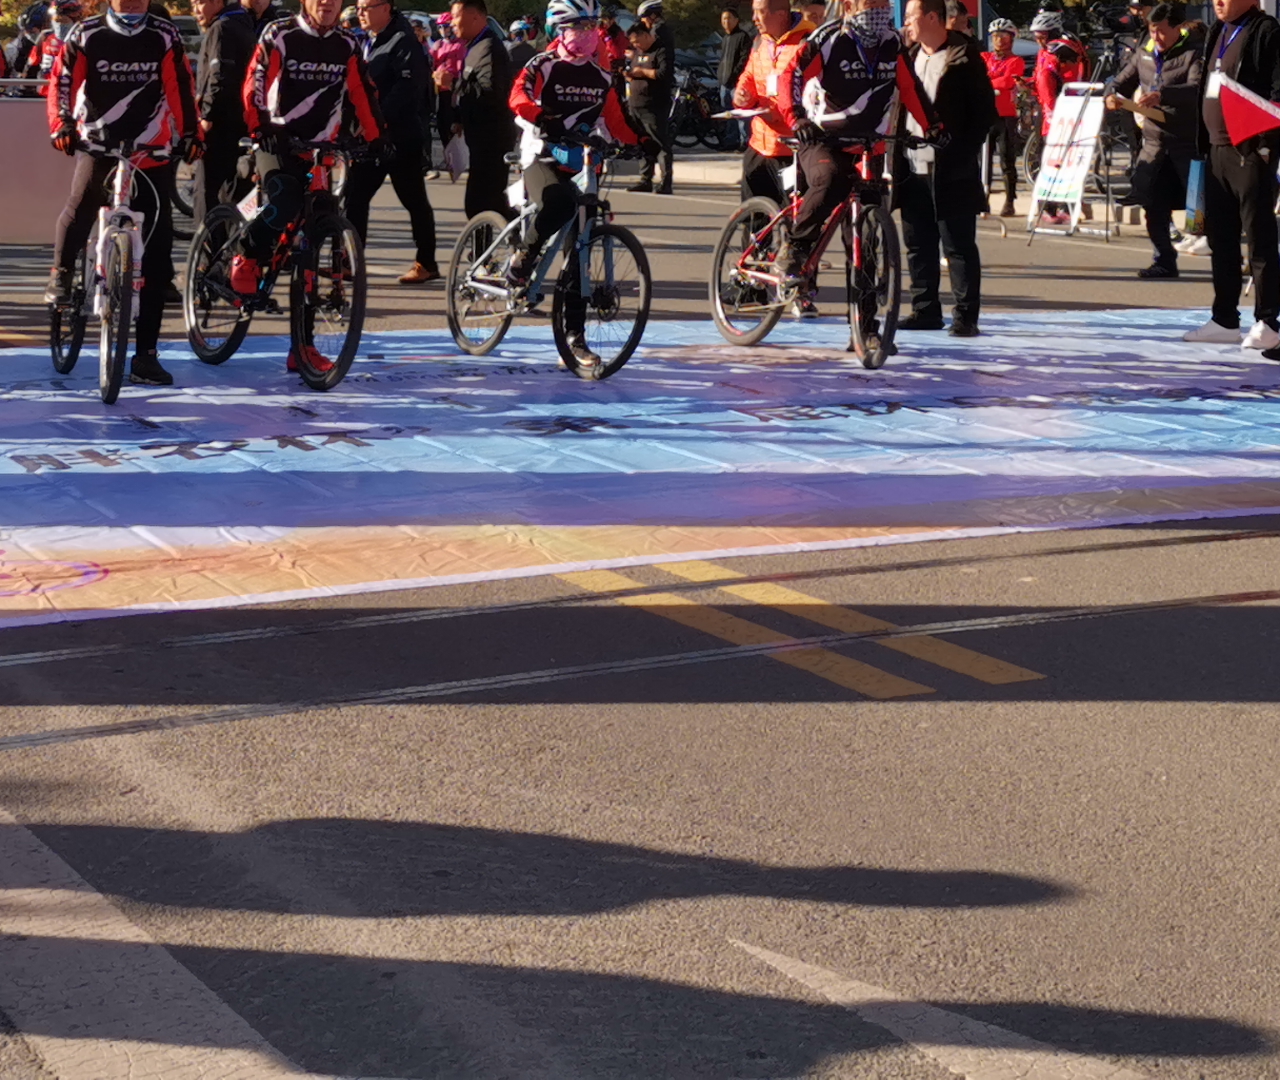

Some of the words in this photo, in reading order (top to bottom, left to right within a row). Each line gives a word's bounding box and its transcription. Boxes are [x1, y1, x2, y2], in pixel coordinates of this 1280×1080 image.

[110, 61, 159, 72] GIANT
[298, 61, 347, 73] GIANT
[565, 85, 605, 96] GIANT
